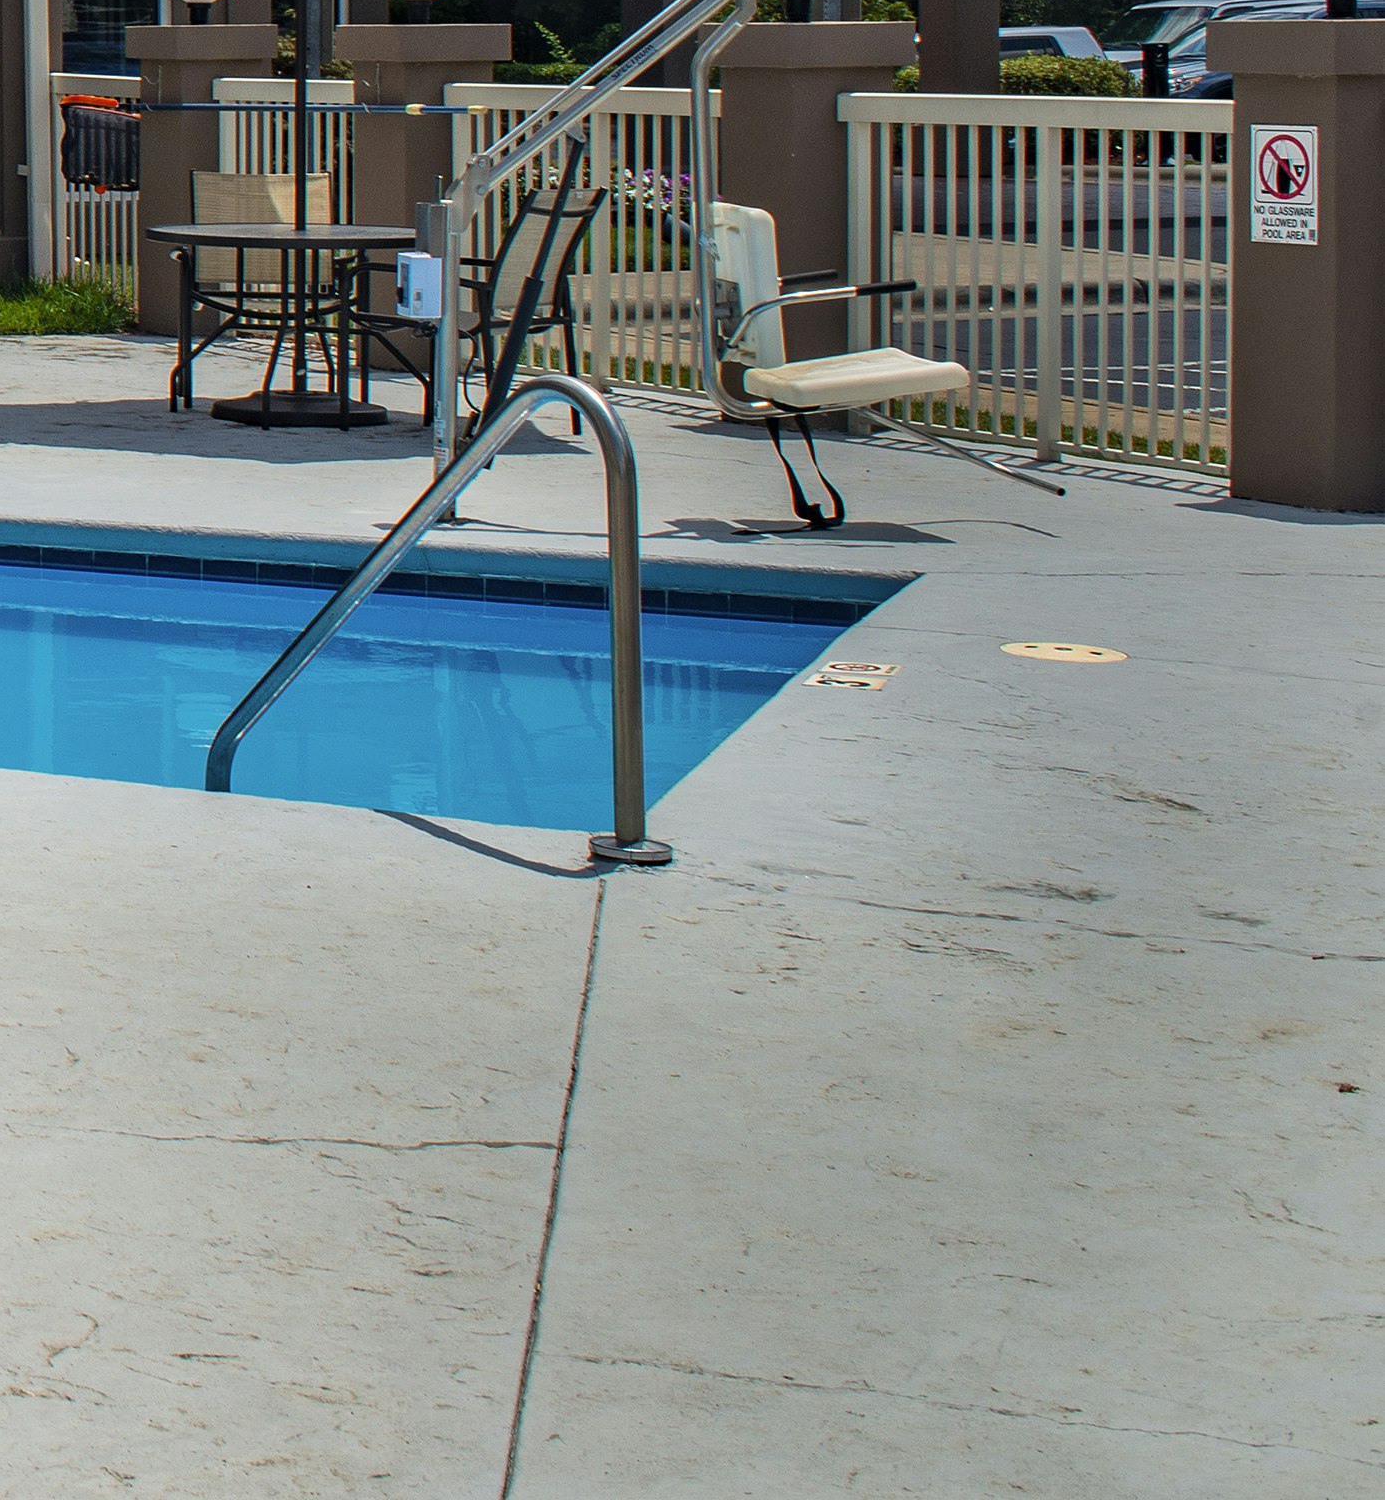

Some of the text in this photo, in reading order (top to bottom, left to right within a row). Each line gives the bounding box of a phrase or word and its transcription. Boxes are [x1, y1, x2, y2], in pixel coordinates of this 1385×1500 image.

[611, 44, 654, 80] SPECTRUM
[1254, 205, 1315, 217] NO GLASSWARE
[1261, 217, 1308, 228] ALLOWED IN
[1262, 229, 1283, 239] POOL
[1286, 230, 1306, 240] AREA
